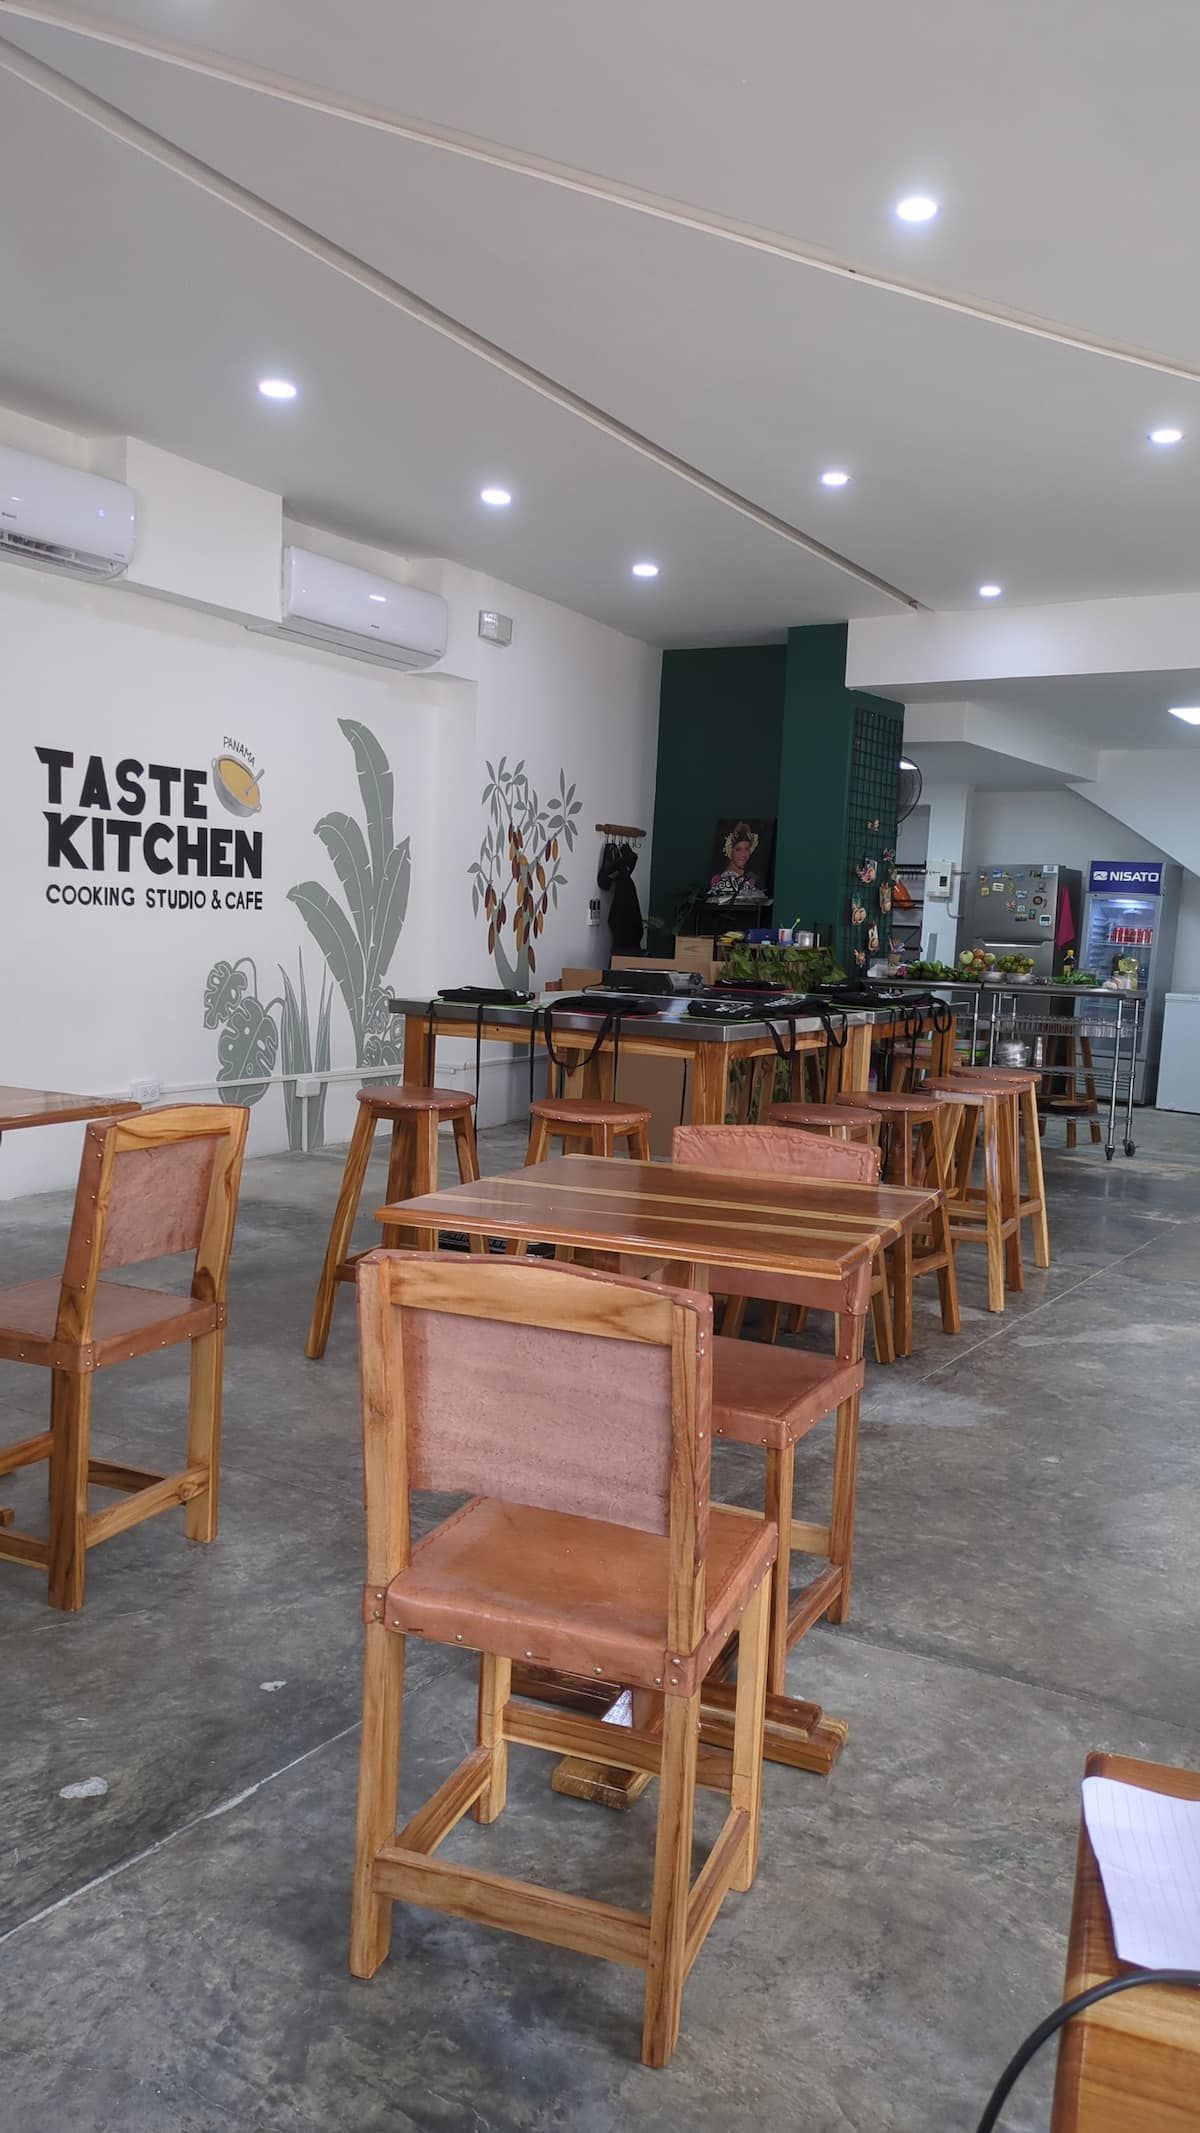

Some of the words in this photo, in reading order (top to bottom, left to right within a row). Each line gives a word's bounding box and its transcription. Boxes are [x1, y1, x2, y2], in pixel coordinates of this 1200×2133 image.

[223, 736, 256, 767] PANAMA
[34, 746, 208, 820] TASTE
[43, 811, 263, 879] KITCHEN
[1110, 871, 1160, 883] NISATO
[46, 884, 135, 907] COOKING
[146, 888, 206, 909] STUDIO
[211, 890, 222, 910] &
[225, 891, 263, 910] CAFE
